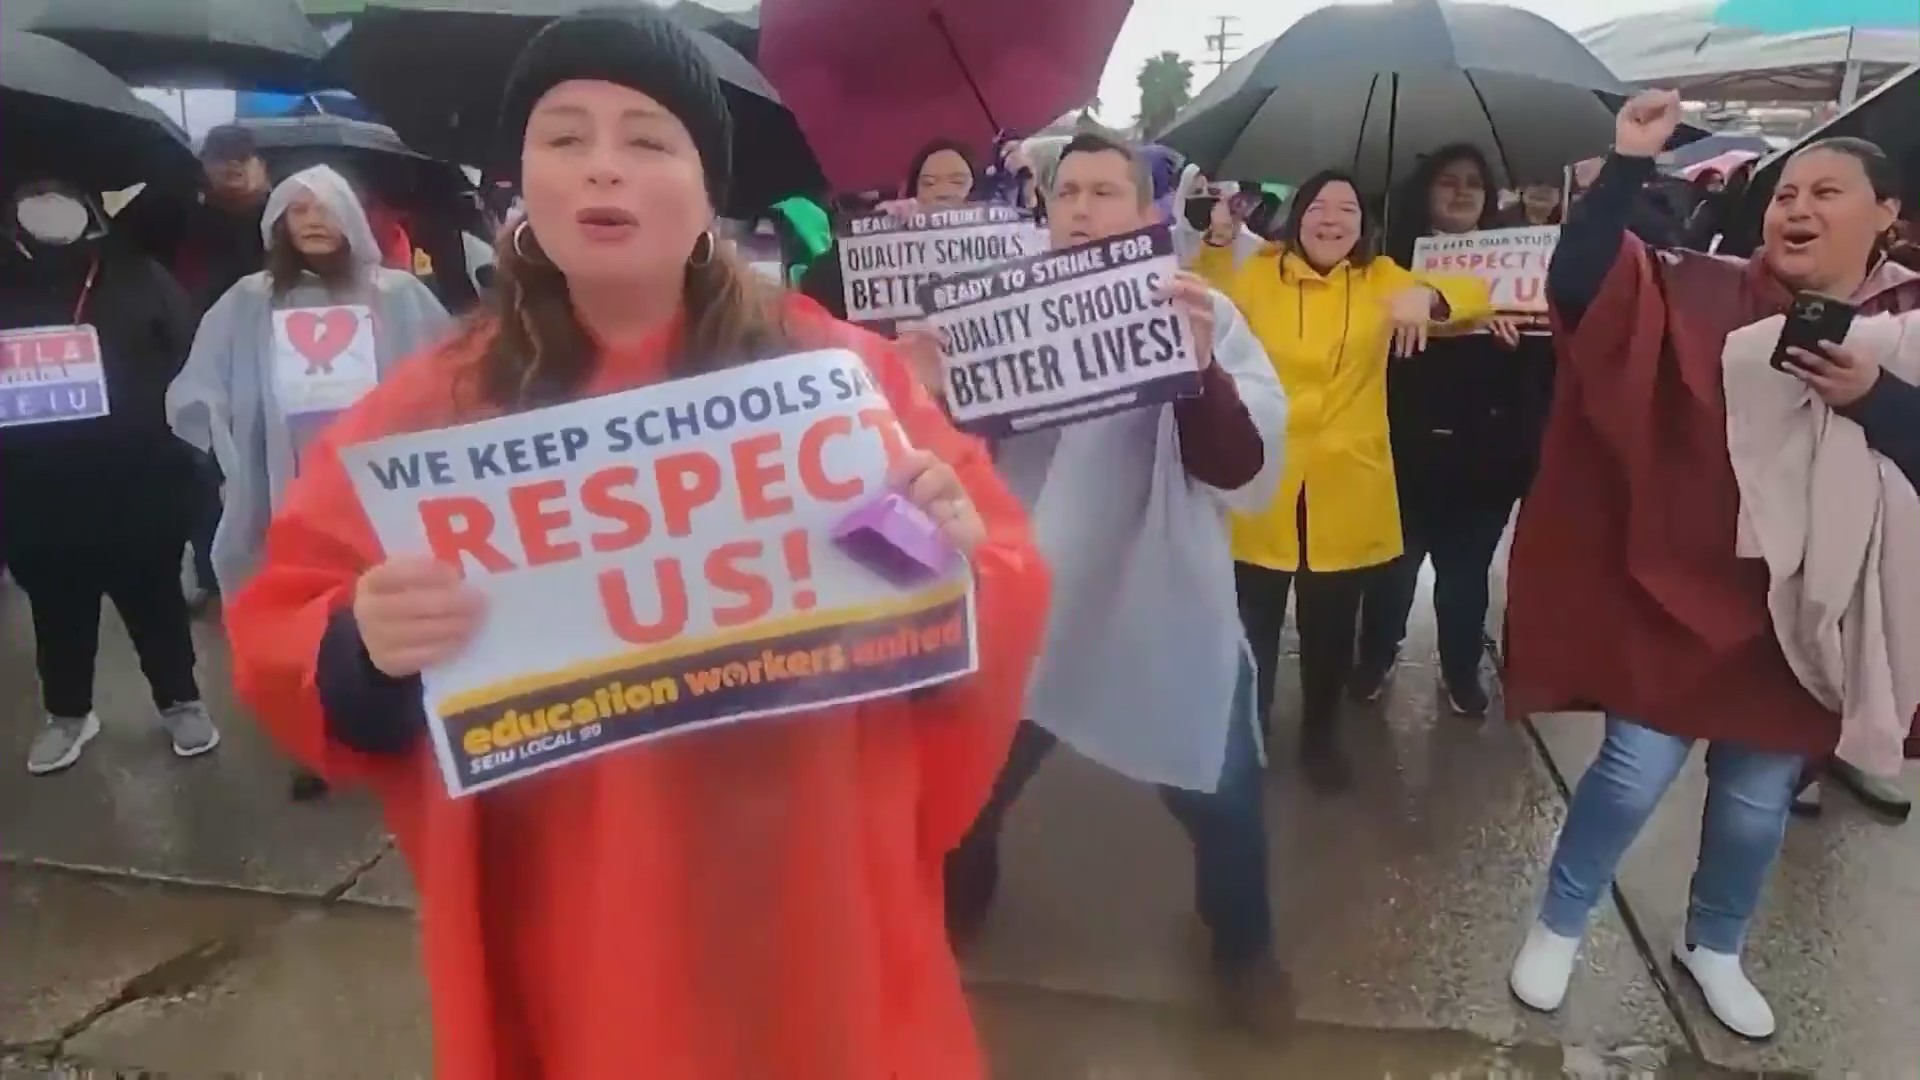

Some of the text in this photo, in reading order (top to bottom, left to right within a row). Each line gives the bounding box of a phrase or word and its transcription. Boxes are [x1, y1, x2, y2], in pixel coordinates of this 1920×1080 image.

[848, 241, 926, 272] QUALITY
[933, 234, 1153, 310] READY TO STRIKE FOR
[1426, 252, 1531, 270] RESPECT
[951, 315, 1186, 407] BETTER LIVES!
[368, 451, 455, 490] WE
[467, 427, 589, 480] KEEP
[605, 374, 822, 453] SCHOOLS
[418, 408, 905, 580] RESPECT
[598, 528, 817, 644] US!
[463, 676, 679, 756] education
[684, 644, 846, 697] workers
[470, 750, 514, 776] SEIU
[519, 731, 577, 761] LOCAL
